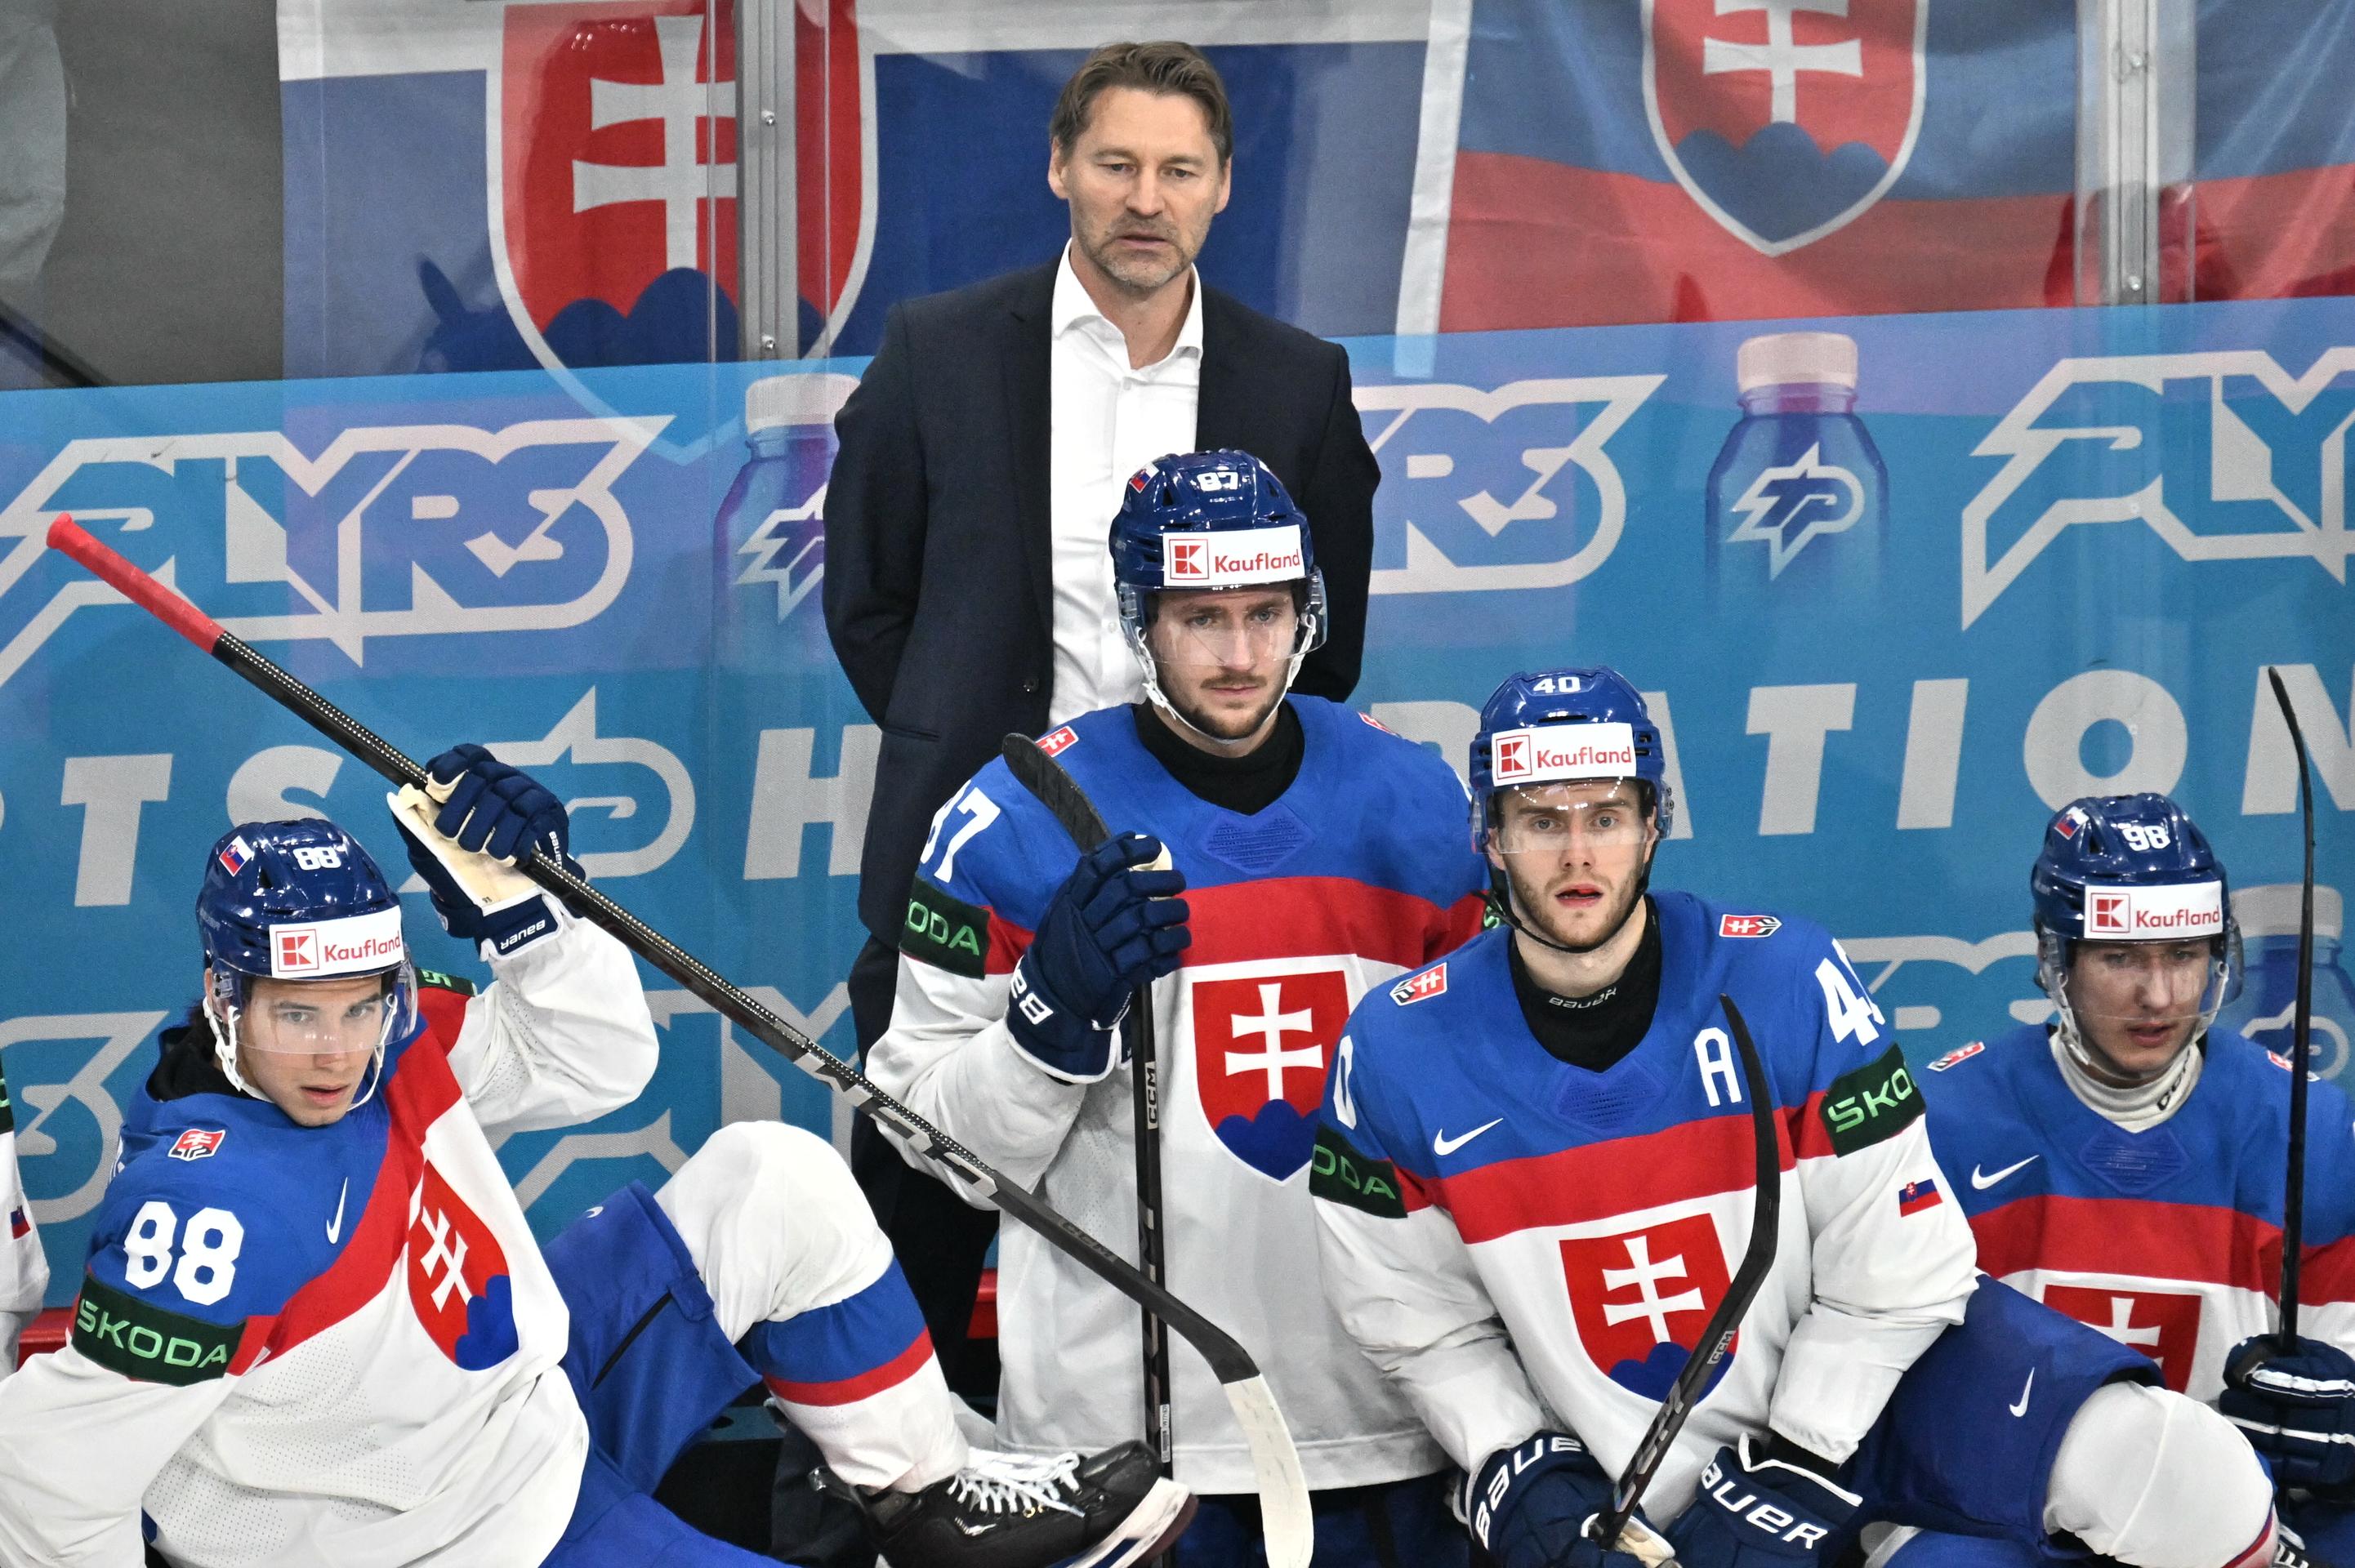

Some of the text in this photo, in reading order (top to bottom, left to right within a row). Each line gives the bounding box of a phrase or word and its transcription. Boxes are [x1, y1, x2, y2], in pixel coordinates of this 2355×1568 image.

[1962, 346, 2355, 631] FLY
[1215, 549, 1300, 573] Kaufland
[1532, 676, 1572, 693] 40
[1537, 746, 1632, 768] Kaufland
[292, 846, 341, 871] 88
[2121, 825, 2171, 852] 98
[906, 901, 980, 956] ODA
[2136, 905, 2220, 928] Kaufland
[323, 930, 401, 962] Kaufland
[1815, 938, 1885, 1046] 4
[1332, 1035, 1357, 1130] 0
[1694, 1027, 1742, 1107] A
[1146, 1067, 1157, 1125] CCM
[1826, 1067, 1916, 1134] SKO
[1312, 1143, 1396, 1200] ODA
[123, 1200, 244, 1306] 88
[1710, 1332, 1735, 1362] CCM
